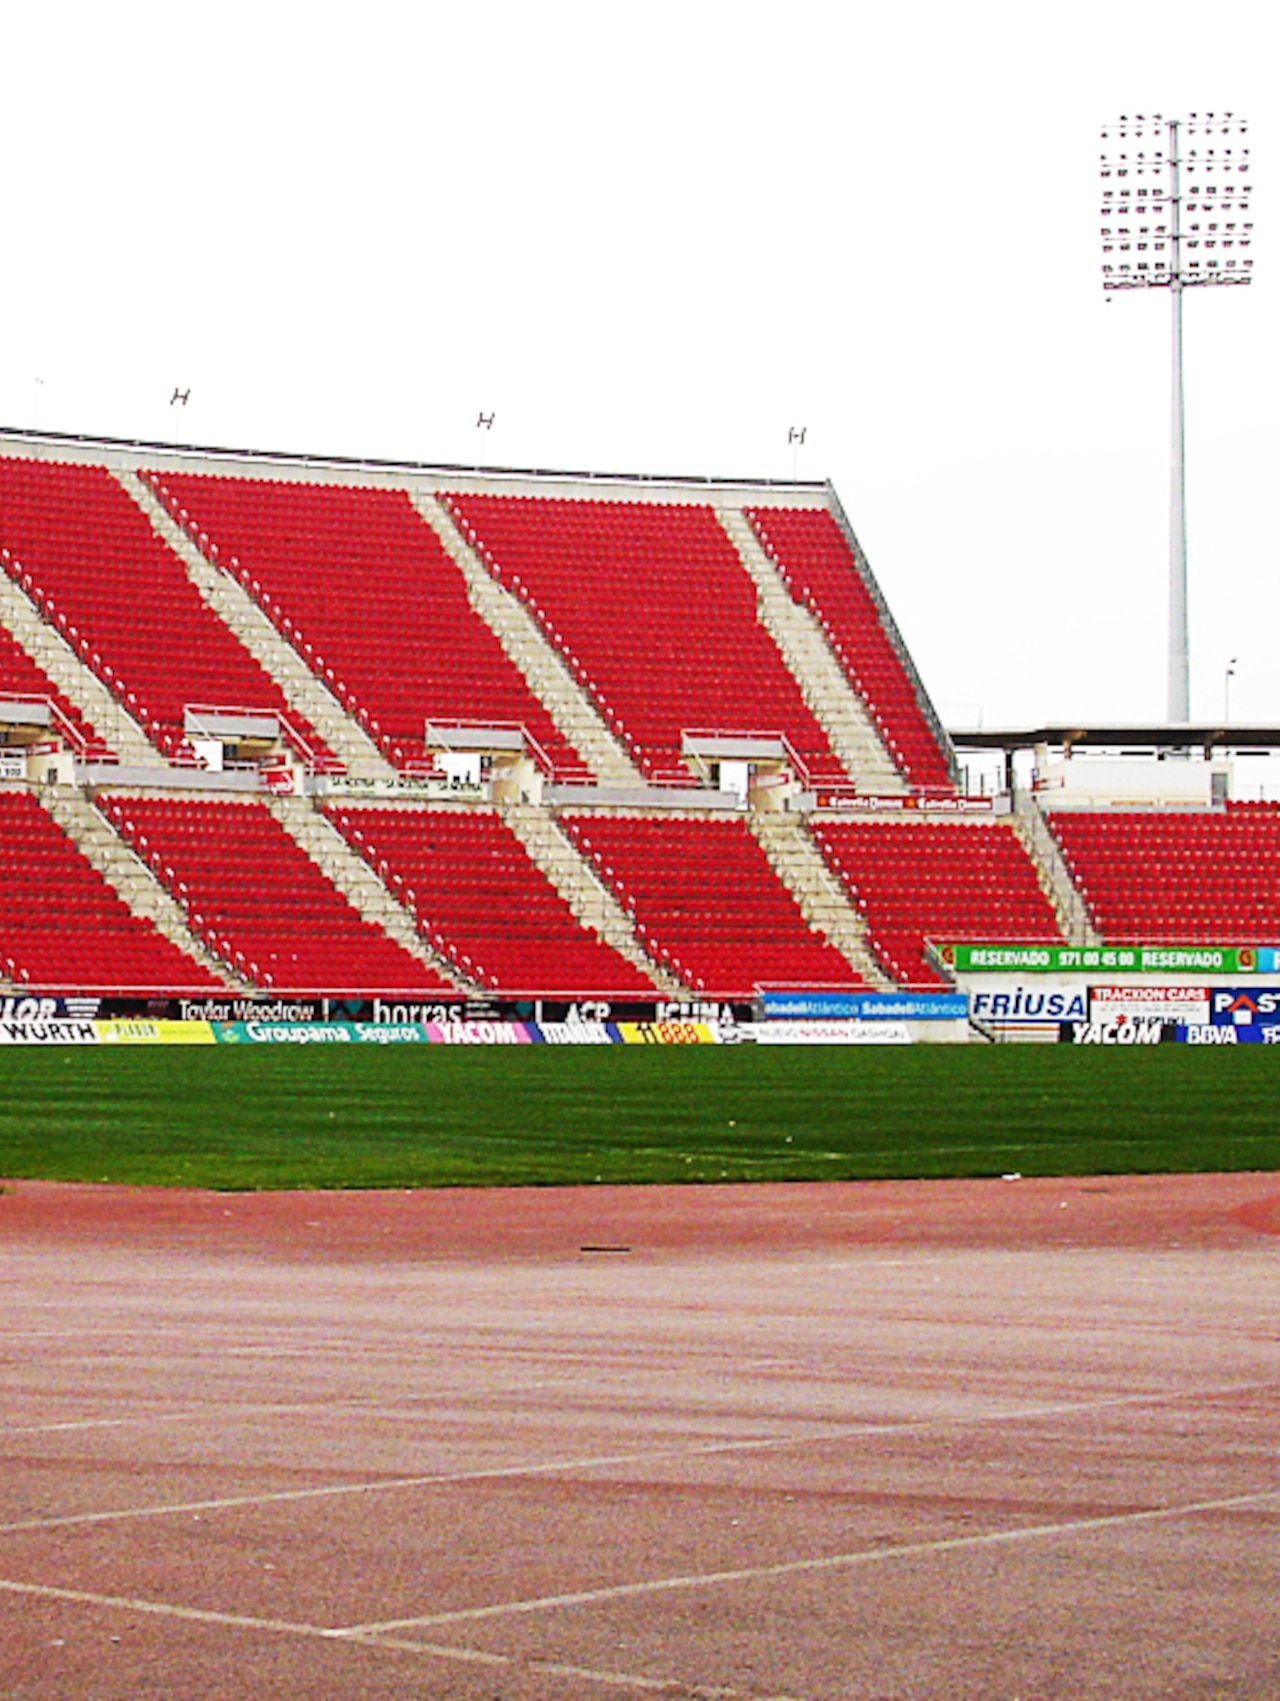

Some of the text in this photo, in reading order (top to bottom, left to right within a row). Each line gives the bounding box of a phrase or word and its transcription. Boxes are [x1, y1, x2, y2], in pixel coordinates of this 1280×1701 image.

[970, 950, 1050, 966] RESERVADO
[1058, 950, 1080, 966] 971
[1142, 951, 1223, 966] RESERVADO
[179, 999, 315, 1021] Taylor Woodrow
[246, 1021, 420, 1044] Groupama Seguros
[437, 1022, 518, 1043] YACOM
[1071, 1023, 1163, 1045] YACOM
[1187, 1025, 1237, 1044] BBVA
